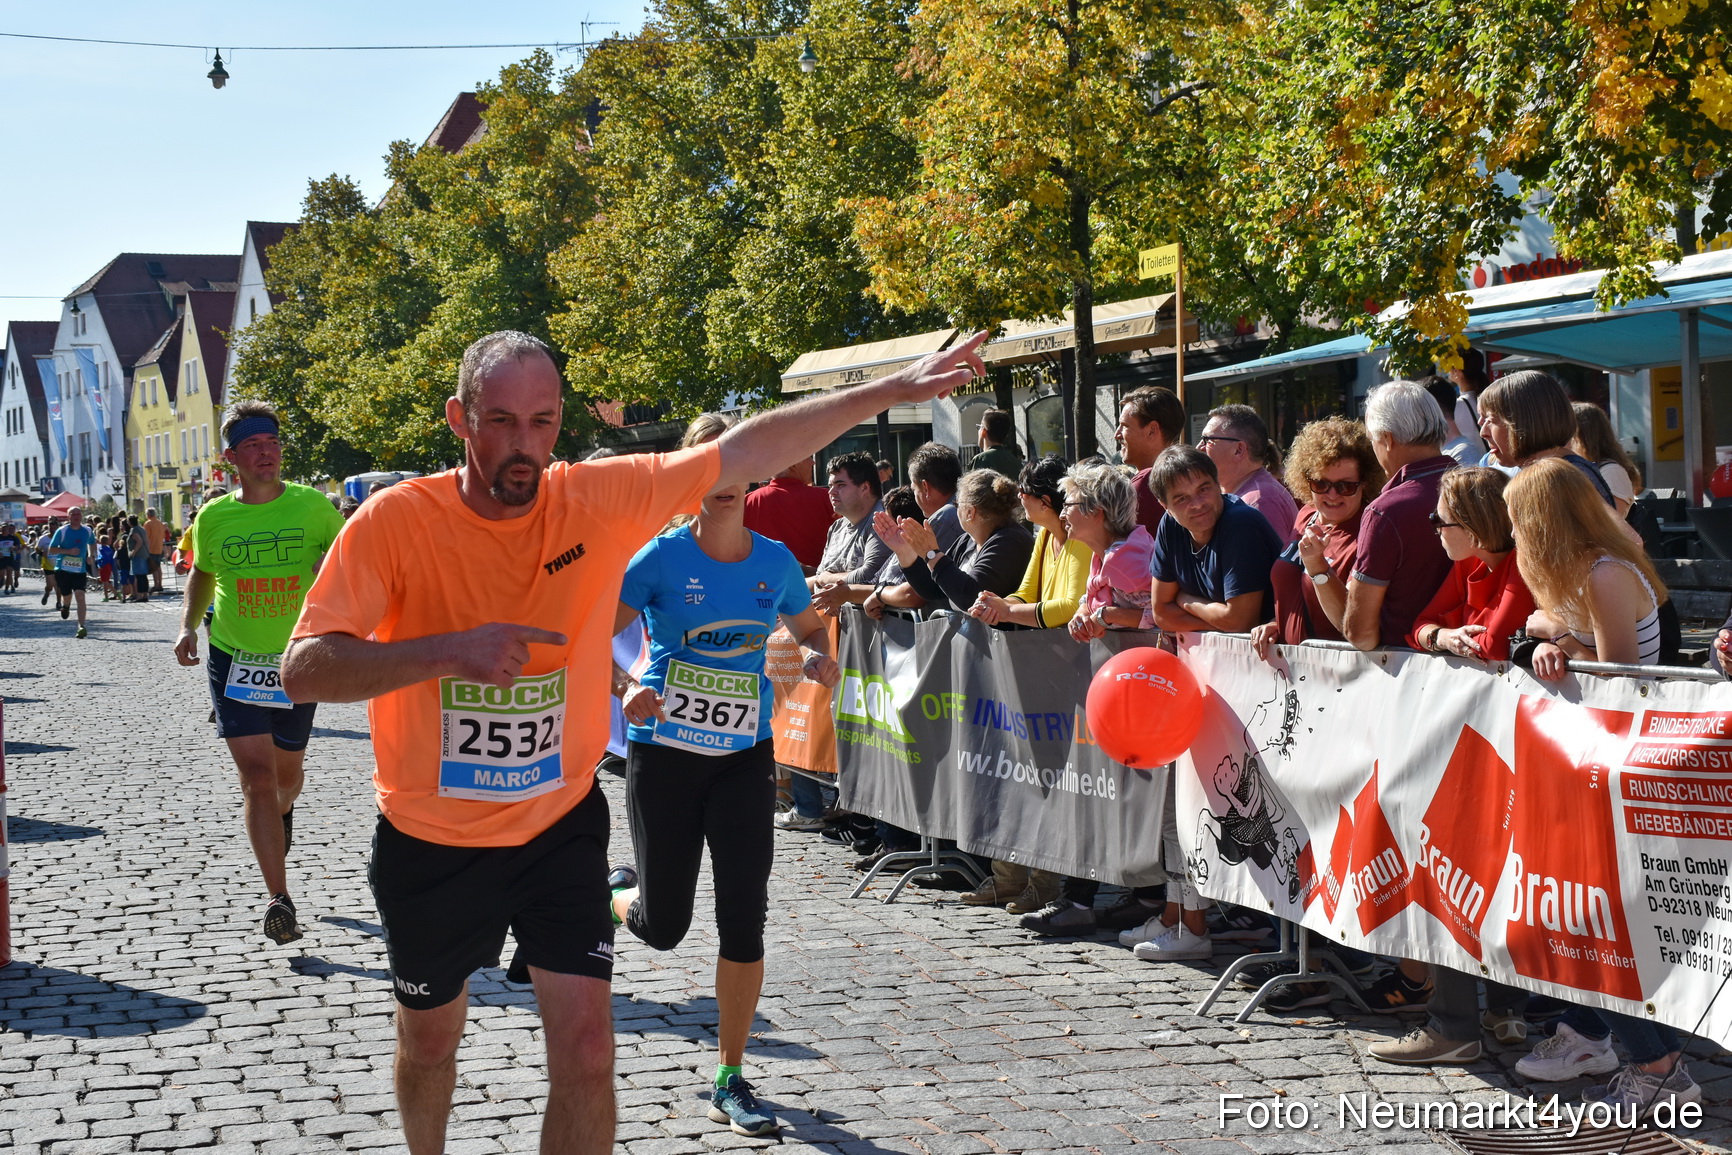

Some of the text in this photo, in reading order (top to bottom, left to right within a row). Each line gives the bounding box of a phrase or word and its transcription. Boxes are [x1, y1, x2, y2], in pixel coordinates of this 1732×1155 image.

[1146, 254, 1176, 270] Toiletten
[222, 528, 304, 565] OPF
[543, 542, 586, 576] THULE
[236, 575, 301, 593] MERZ
[238, 592, 299, 606] PREMIUM
[238, 601, 299, 618] REISEN
[238, 650, 283, 666] BOC
[236, 668, 283, 688] 208
[673, 665, 754, 696] BOCK
[1116, 664, 1178, 692] RÖDL
[1148, 681, 1177, 697] energie
[246, 690, 274, 700] JÖRG
[452, 675, 561, 709] BOCK
[670, 693, 749, 729] 2367
[459, 715, 555, 758] 2532
[1649, 716, 1727, 735] BINDESTRICKE
[677, 728, 734, 748] NICOLE
[474, 766, 541, 787] MARCO
[1503, 789, 1516, 830] Seit 1929
[1416, 821, 1485, 924] Braun
[1641, 853, 1729, 876] Braun GmbH
[1350, 846, 1403, 908] Braun
[1373, 891, 1391, 907] Sicher
[1507, 852, 1617, 942] Braun
[1645, 875, 1731, 904] Am Grünberg
[1453, 910, 1461, 926] ist
[1647, 895, 1702, 917] D-92318
[1654, 925, 1680, 944] Tel.
[1682, 928, 1714, 950] 09181
[1549, 938, 1637, 970] Sicher ist sicher
[1659, 946, 1683, 965] Fax
[1685, 950, 1714, 974] 09181
